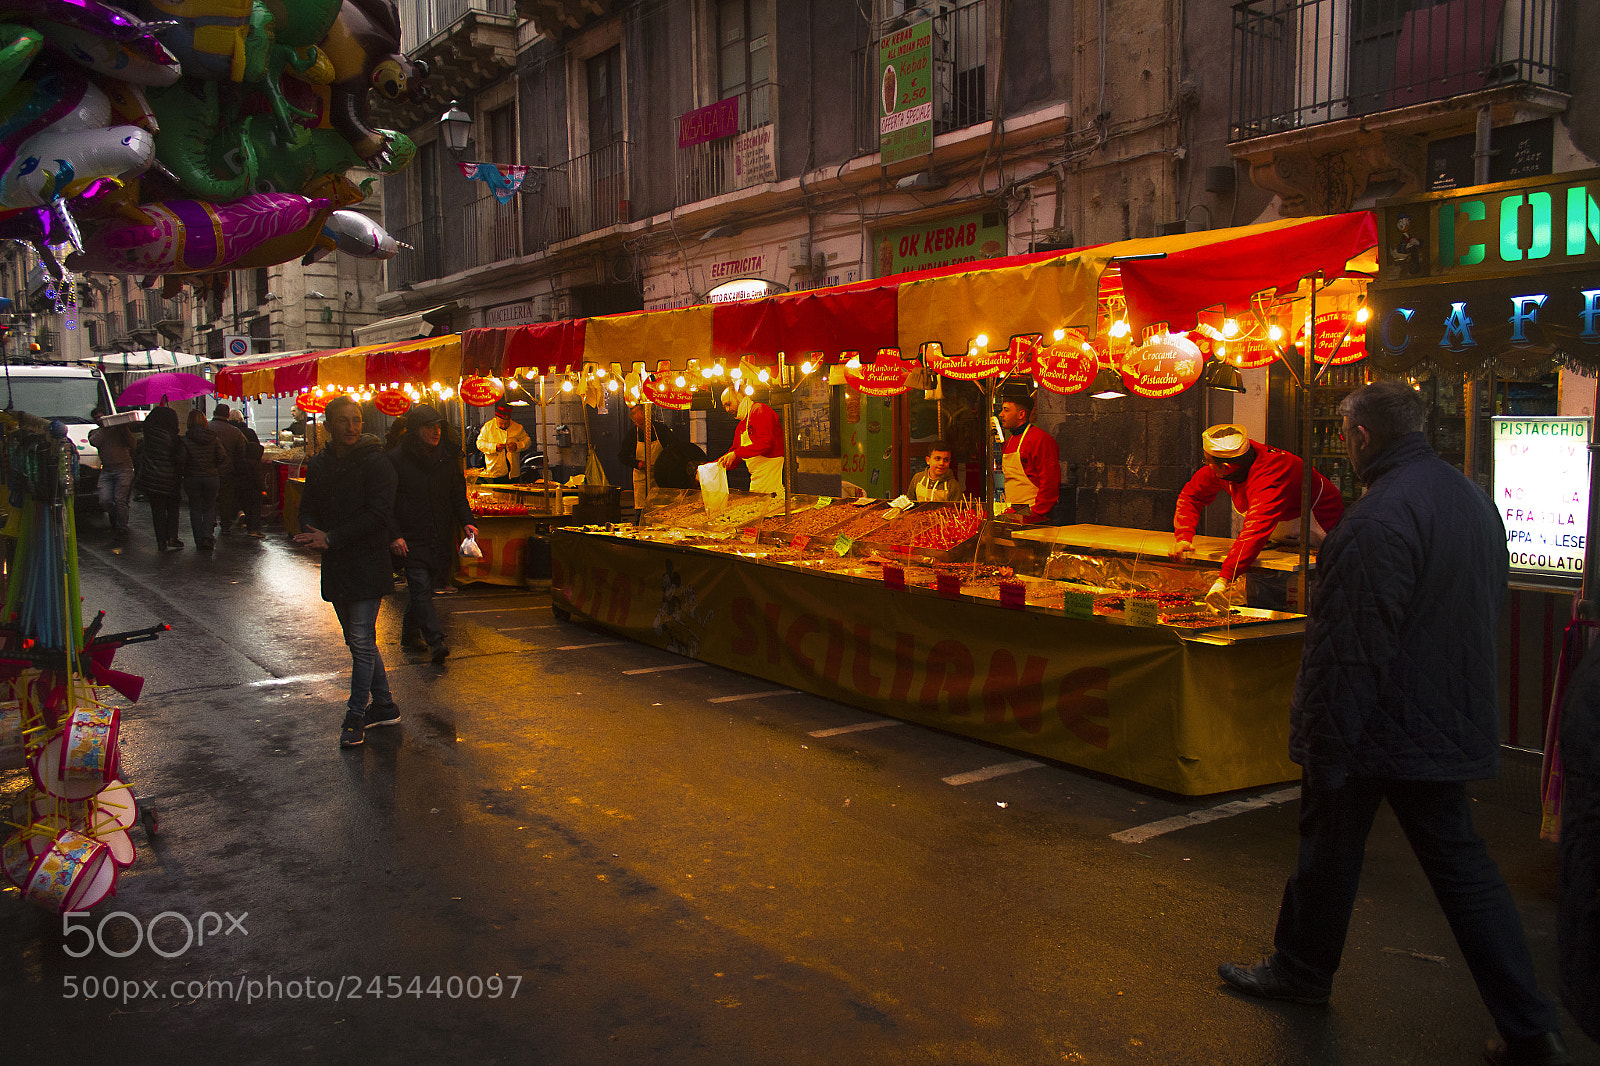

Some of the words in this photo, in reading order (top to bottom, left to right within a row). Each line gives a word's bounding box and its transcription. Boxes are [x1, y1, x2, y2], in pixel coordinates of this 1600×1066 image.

[881, 37, 891, 49] OK
[892, 28, 913, 46] KEBAB
[917, 34, 931, 49] FOOD
[900, 51, 927, 77] Kebab
[901, 87, 927, 104] 2,50
[881, 112, 905, 132] OFFERTA
[906, 104, 931, 125] SPECIALE
[899, 234, 920, 258] OK
[924, 222, 977, 254] KEBAB
[933, 357, 967, 369] Mandorla
[975, 355, 1010, 366] Pistacchio
[1142, 350, 1178, 361] Croccante
[867, 363, 900, 372] Mandorle
[944, 369, 977, 379] PRODUZIONE
[978, 366, 1000, 378] PROPRIA
[1039, 367, 1067, 379] Mandorla
[1153, 360, 1162, 372] al
[1140, 373, 1178, 385] Pistacchio
[1134, 384, 1162, 397] PRODUZIONE
[1163, 382, 1184, 396] PROPRIA
[1500, 422, 1584, 436] PISTACCHIO
[842, 454, 866, 474] 2,50
[730, 597, 1111, 750] SICILIANE
